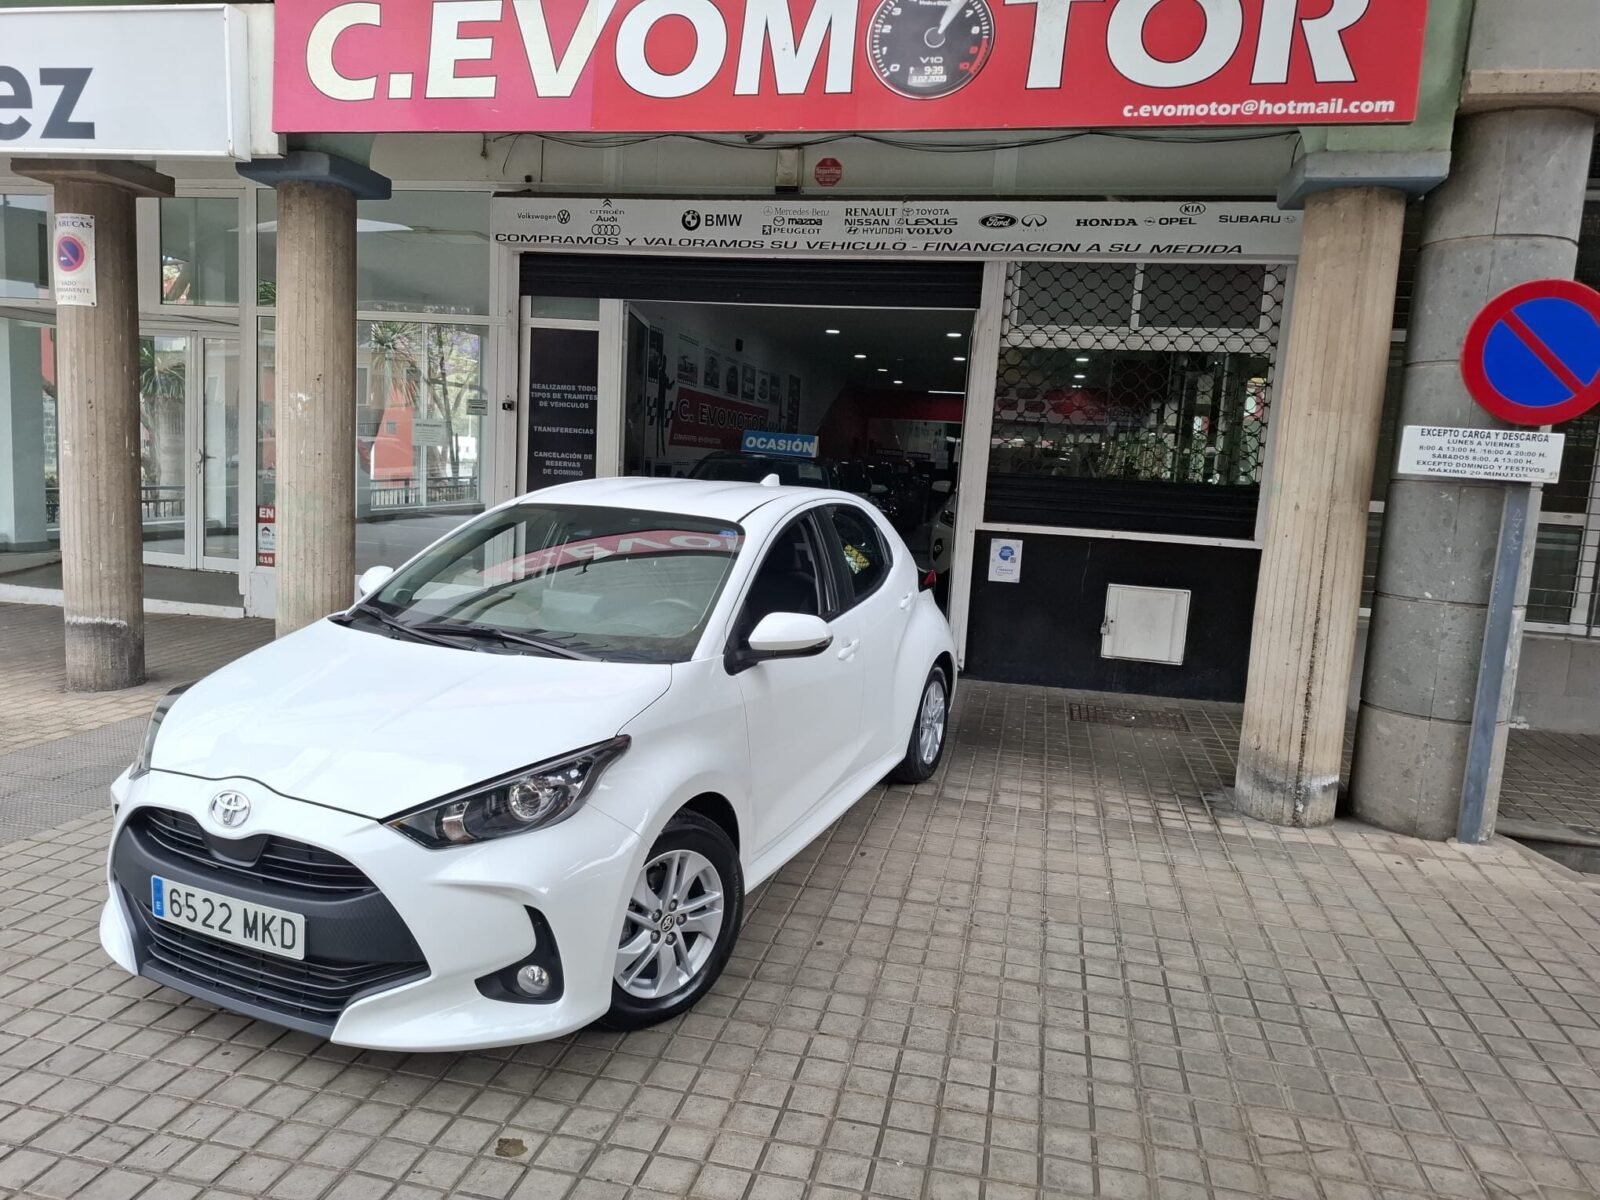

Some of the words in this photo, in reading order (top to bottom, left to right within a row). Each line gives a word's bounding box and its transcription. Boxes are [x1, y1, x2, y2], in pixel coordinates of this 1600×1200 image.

[0, 65, 95, 140] ez
[1122, 98, 1396, 118] c.evomotor@hotmail.com
[845, 207, 898, 217] RENAULT
[915, 208, 950, 216] TOYOTA
[1183, 204, 1202, 214] KIA
[517, 212, 557, 221] Volkswagen
[595, 215, 618, 223] Audi
[704, 213, 743, 227] BMW
[1158, 216, 1197, 226] OPEL
[1218, 214, 1282, 224] SUBARU
[844, 218, 890, 227] NISSAN
[905, 217, 959, 227] LEXUS
[1075, 217, 1139, 227] HONDA
[773, 227, 821, 235] PEUGEOT
[862, 227, 903, 235] HYUNDAI
[495, 232, 619, 246] COMPRAMOS
[625, 236, 637, 246] Y
[643, 236, 765, 249] VALORAMOS
[770, 240, 798, 250] SU
[806, 240, 906, 251] VEHICULO
[923, 241, 1081, 252] FINANCIACION
[1086, 243, 1101, 253] A
[1108, 243, 1142, 253] SU
[1150, 244, 1243, 254] MEDIDA
[532, 383, 576, 391] REALIZAMOS
[550, 401, 589, 409] VEHICULOS
[533, 426, 594, 434] TRANSFERENCIAS
[1420, 427, 1460, 438] EXCEPTO
[1462, 430, 1491, 439] CARGA
[1494, 431, 1500, 440] Y
[1502, 432, 1549, 443] DESCARGA
[745, 434, 815, 454] OCASIÓN
[1447, 438, 1474, 446] LUNES
[1485, 441, 1521, 449] VIERNES
[533, 451, 582, 460] CANCELACIÓN
[545, 460, 580, 468] RESERVAS
[1416, 459, 1454, 468] EXCEPTO
[1455, 462, 1495, 470] DOMINGO
[1504, 465, 1545, 474] FESTIVOS
[553, 468, 583, 477] DOMINIO
[259, 507, 274, 519] EN
[169, 888, 232, 934] 6522
[243, 908, 297, 950] MKD
